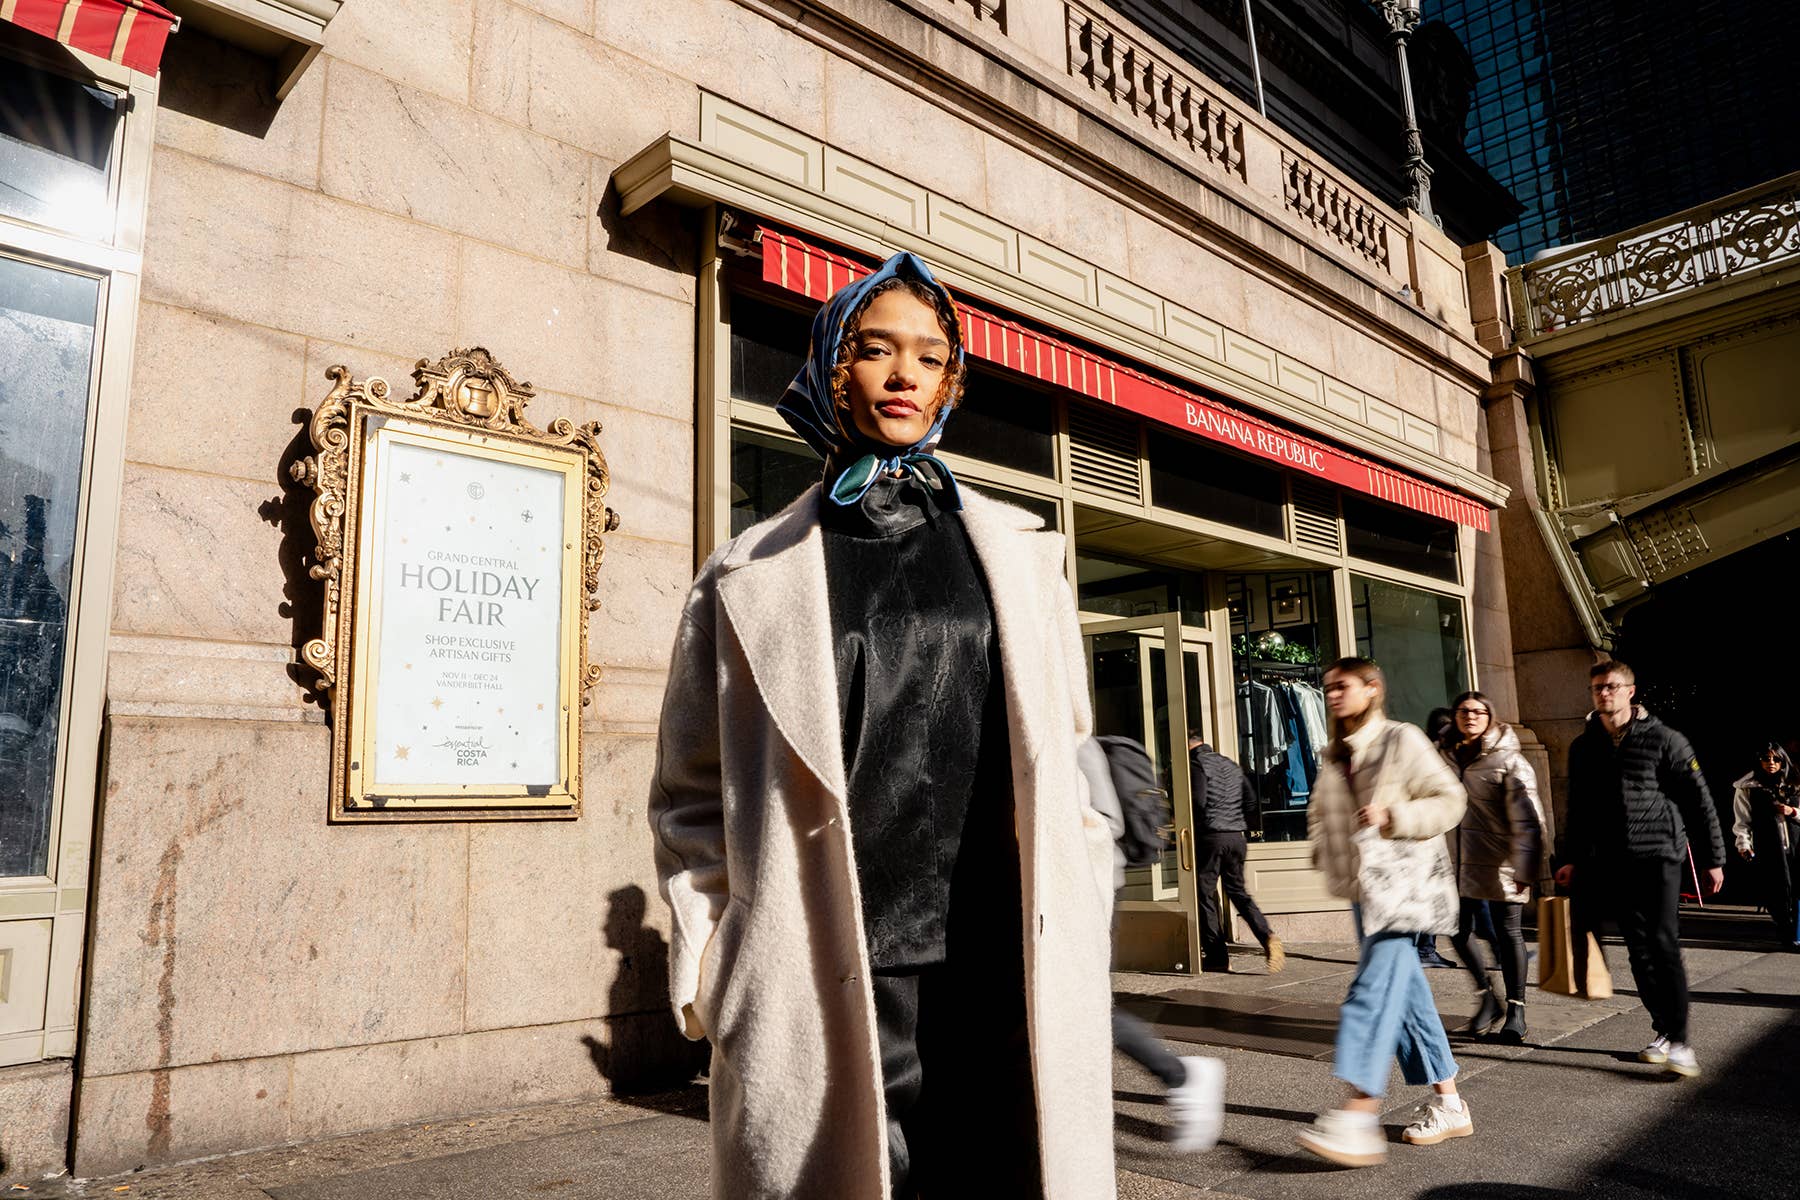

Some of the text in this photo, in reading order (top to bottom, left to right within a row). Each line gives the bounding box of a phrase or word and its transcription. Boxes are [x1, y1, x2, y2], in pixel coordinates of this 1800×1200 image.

[1185, 402, 1325, 472] BANANA REPUBLIC
[427, 550, 519, 570] GRAND CENTRAL
[400, 563, 540, 601] HOLIDAY
[438, 597, 505, 627] FAIR
[425, 633, 516, 651] SHOP EXCLUSIVE
[429, 648, 512, 663] ARTISAN GIFTS
[442, 671, 460, 680] NOV
[473, 673, 488, 681] DEC
[489, 674, 498, 682] 24
[436, 680, 503, 690] VANDERBILT HALL
[457, 749, 488, 759] COSTA
[457, 758, 479, 766] RICA
